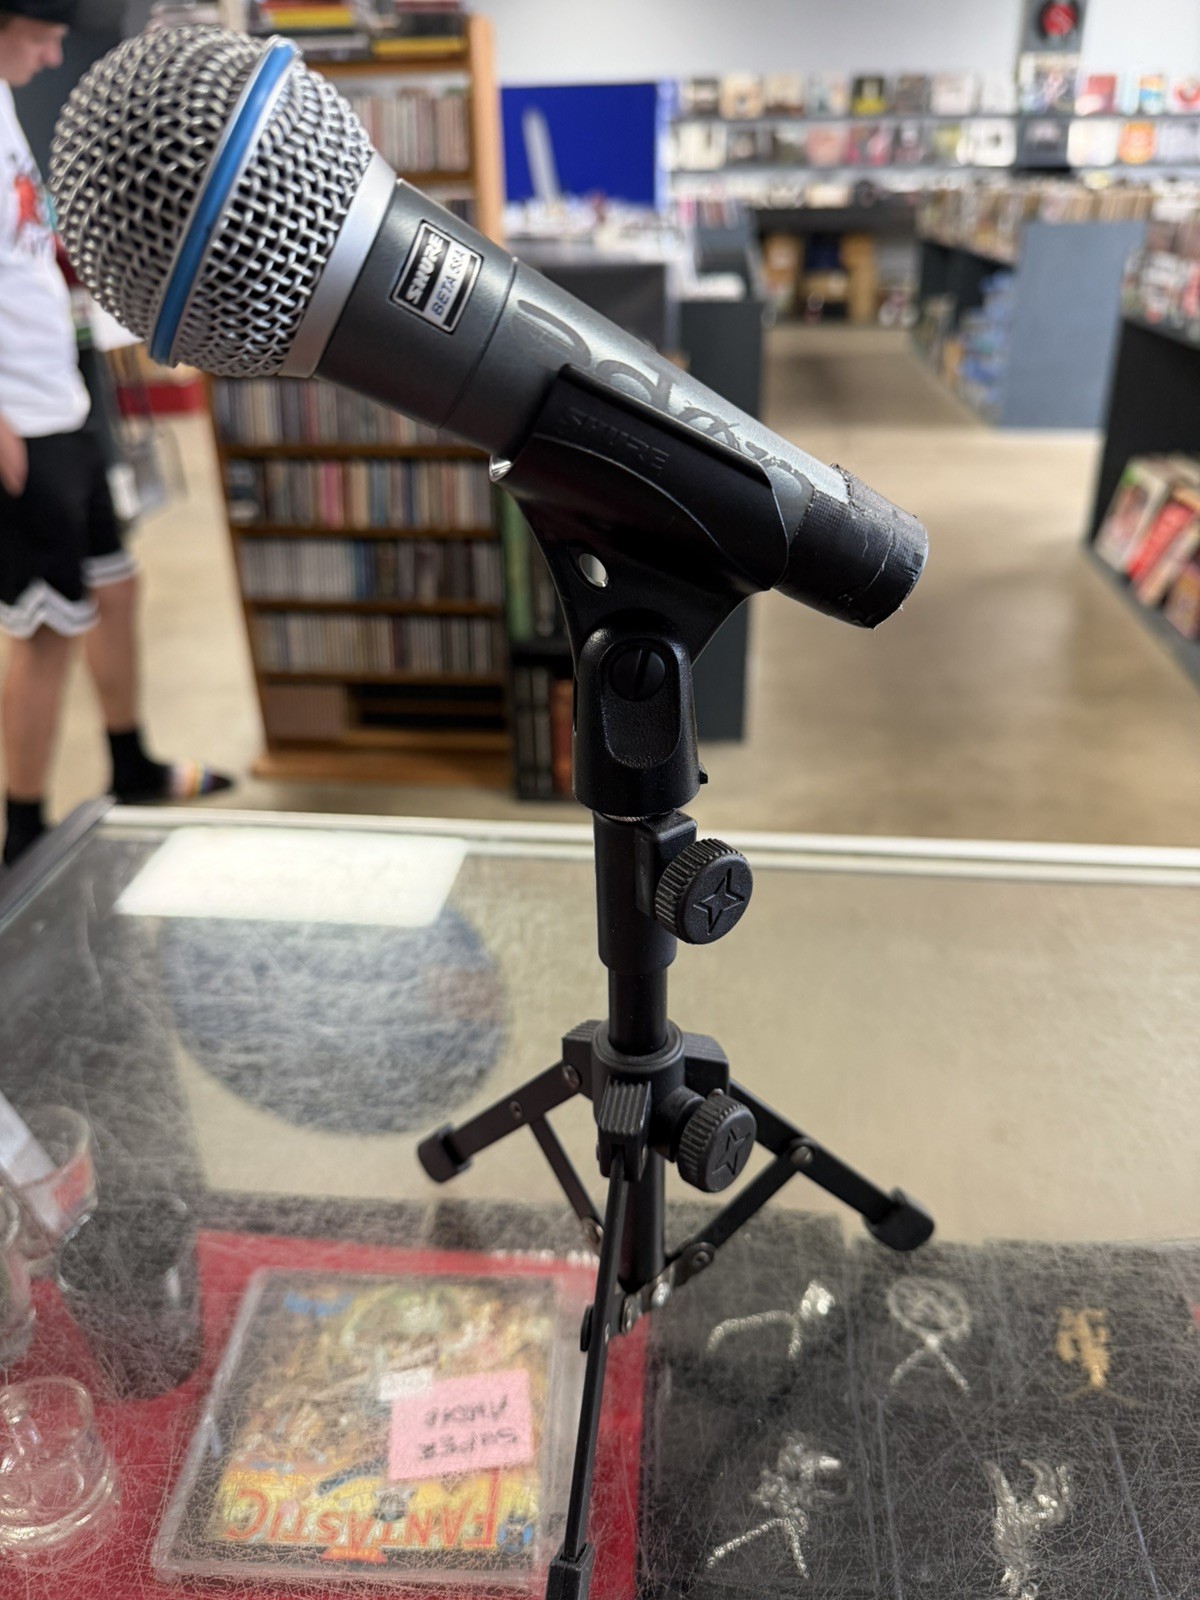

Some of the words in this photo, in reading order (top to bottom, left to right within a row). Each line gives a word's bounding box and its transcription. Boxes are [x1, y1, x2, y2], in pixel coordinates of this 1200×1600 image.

[405, 232, 444, 305] SHURE
[431, 275, 456, 316] BETA
[557, 405, 671, 472] SHURE
[223, 1468, 500, 1549] FANTASTIC
